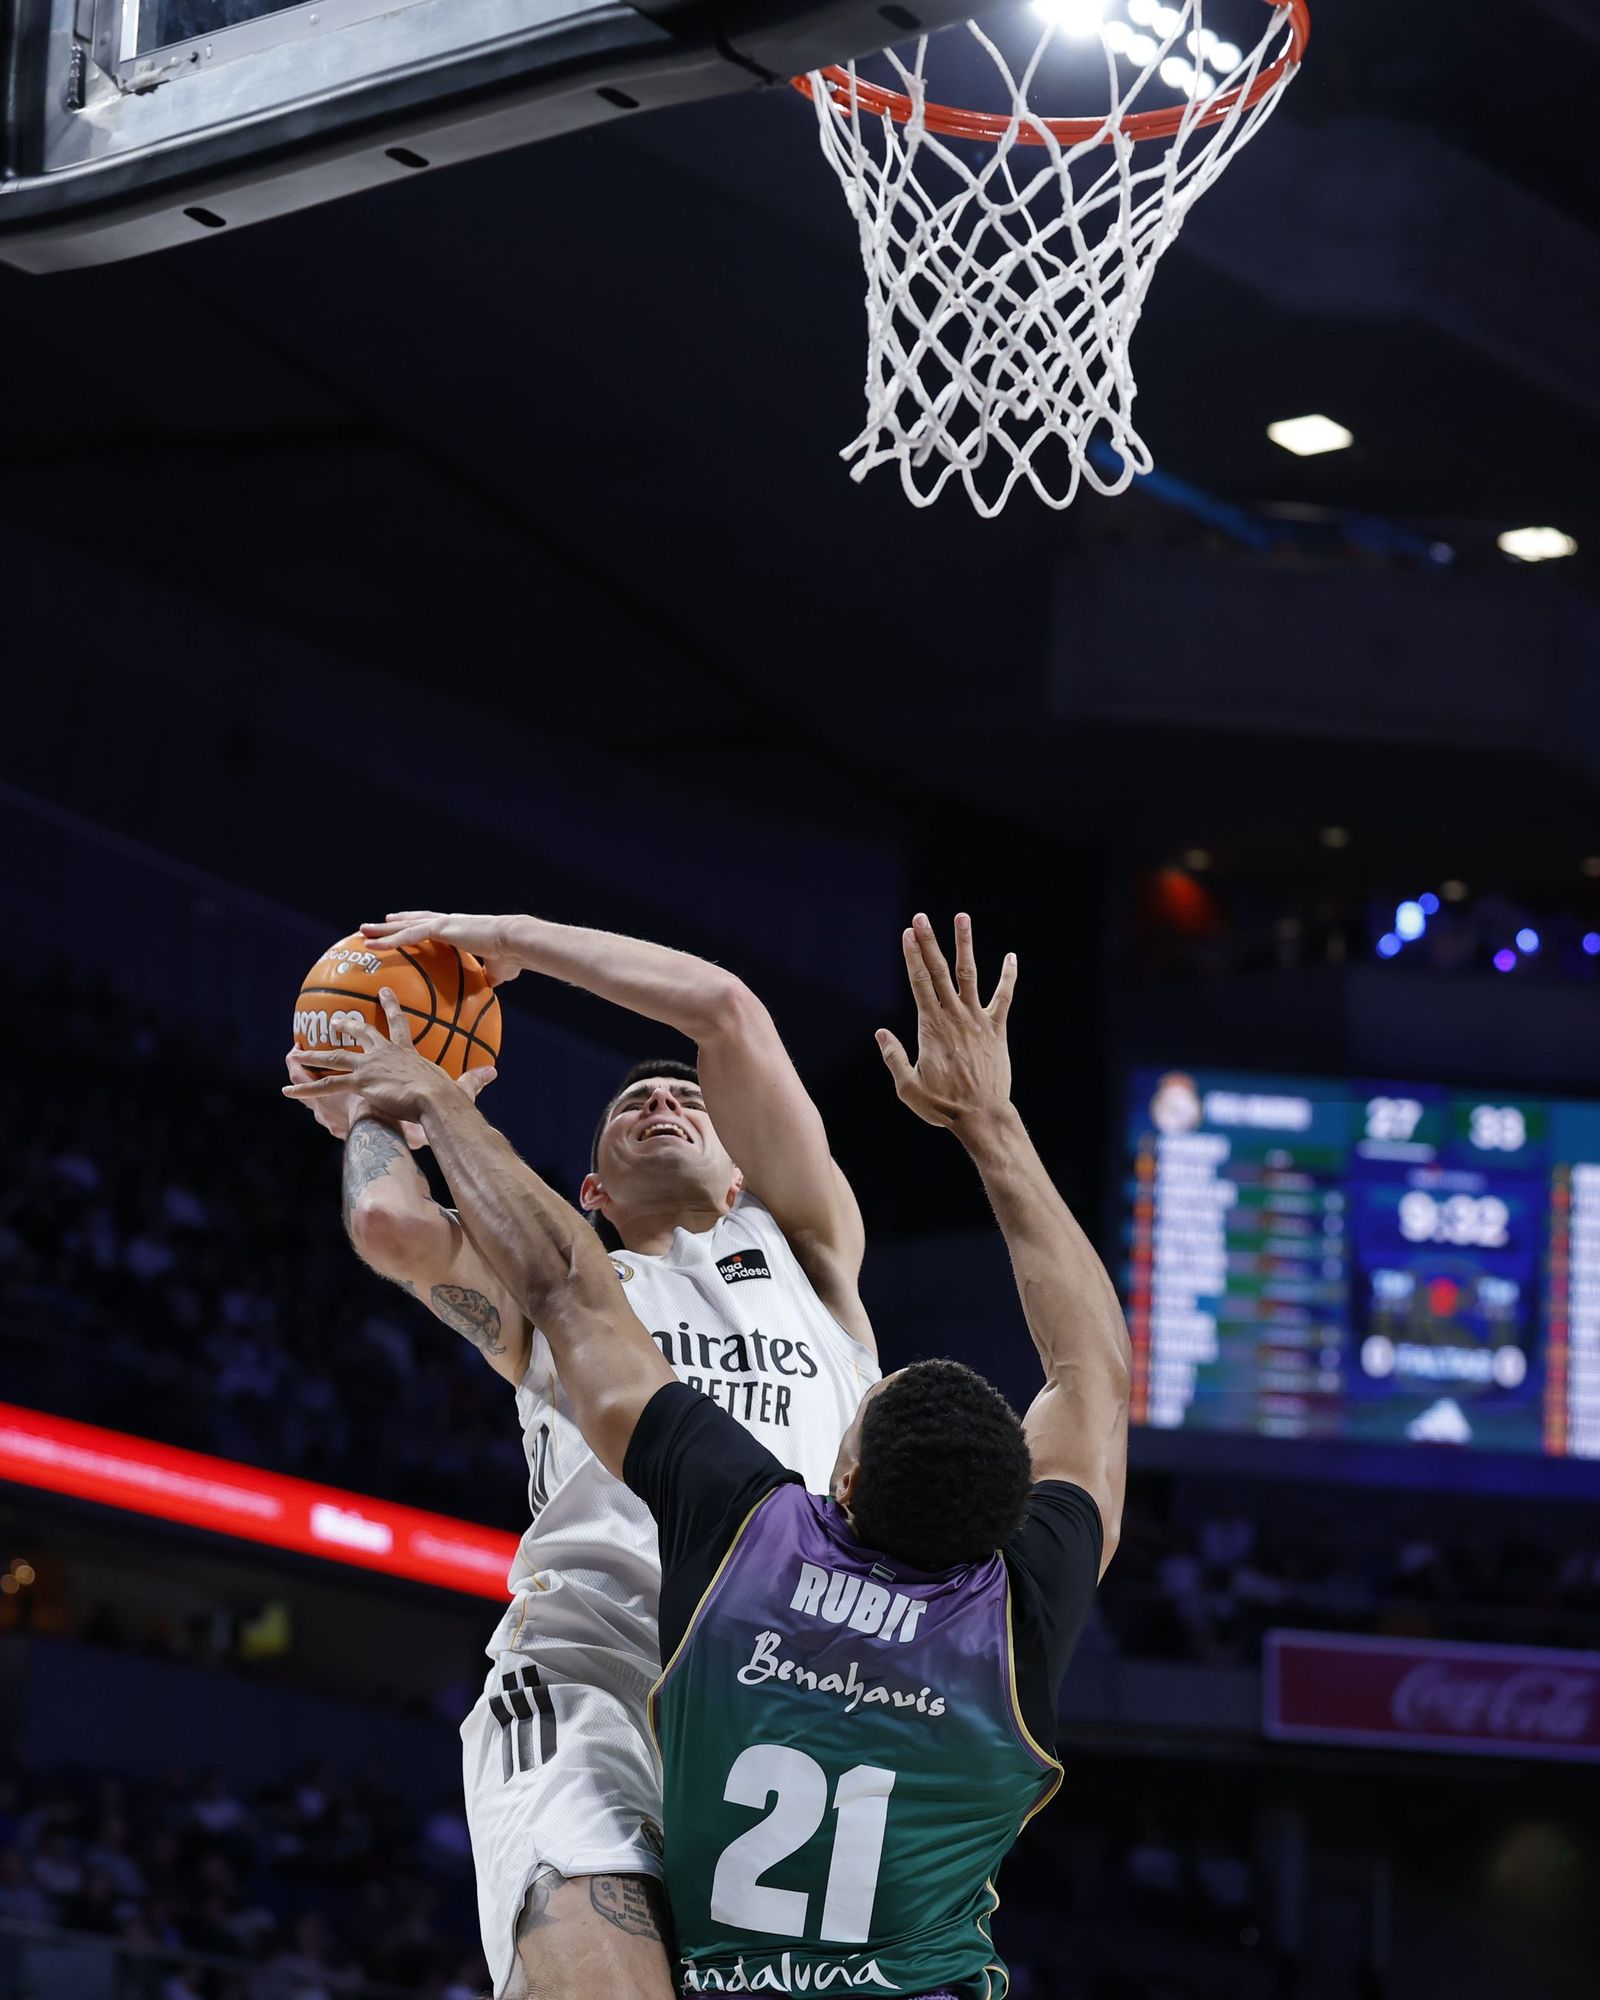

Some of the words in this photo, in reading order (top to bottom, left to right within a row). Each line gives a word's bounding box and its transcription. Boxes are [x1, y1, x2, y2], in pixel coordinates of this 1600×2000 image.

[1366, 1096, 1423, 1140] 27
[719, 1260, 743, 1275] liga
[724, 1265, 770, 1282] endesa
[789, 1561, 928, 1644] RUBIT
[709, 1743, 897, 1945] 21
